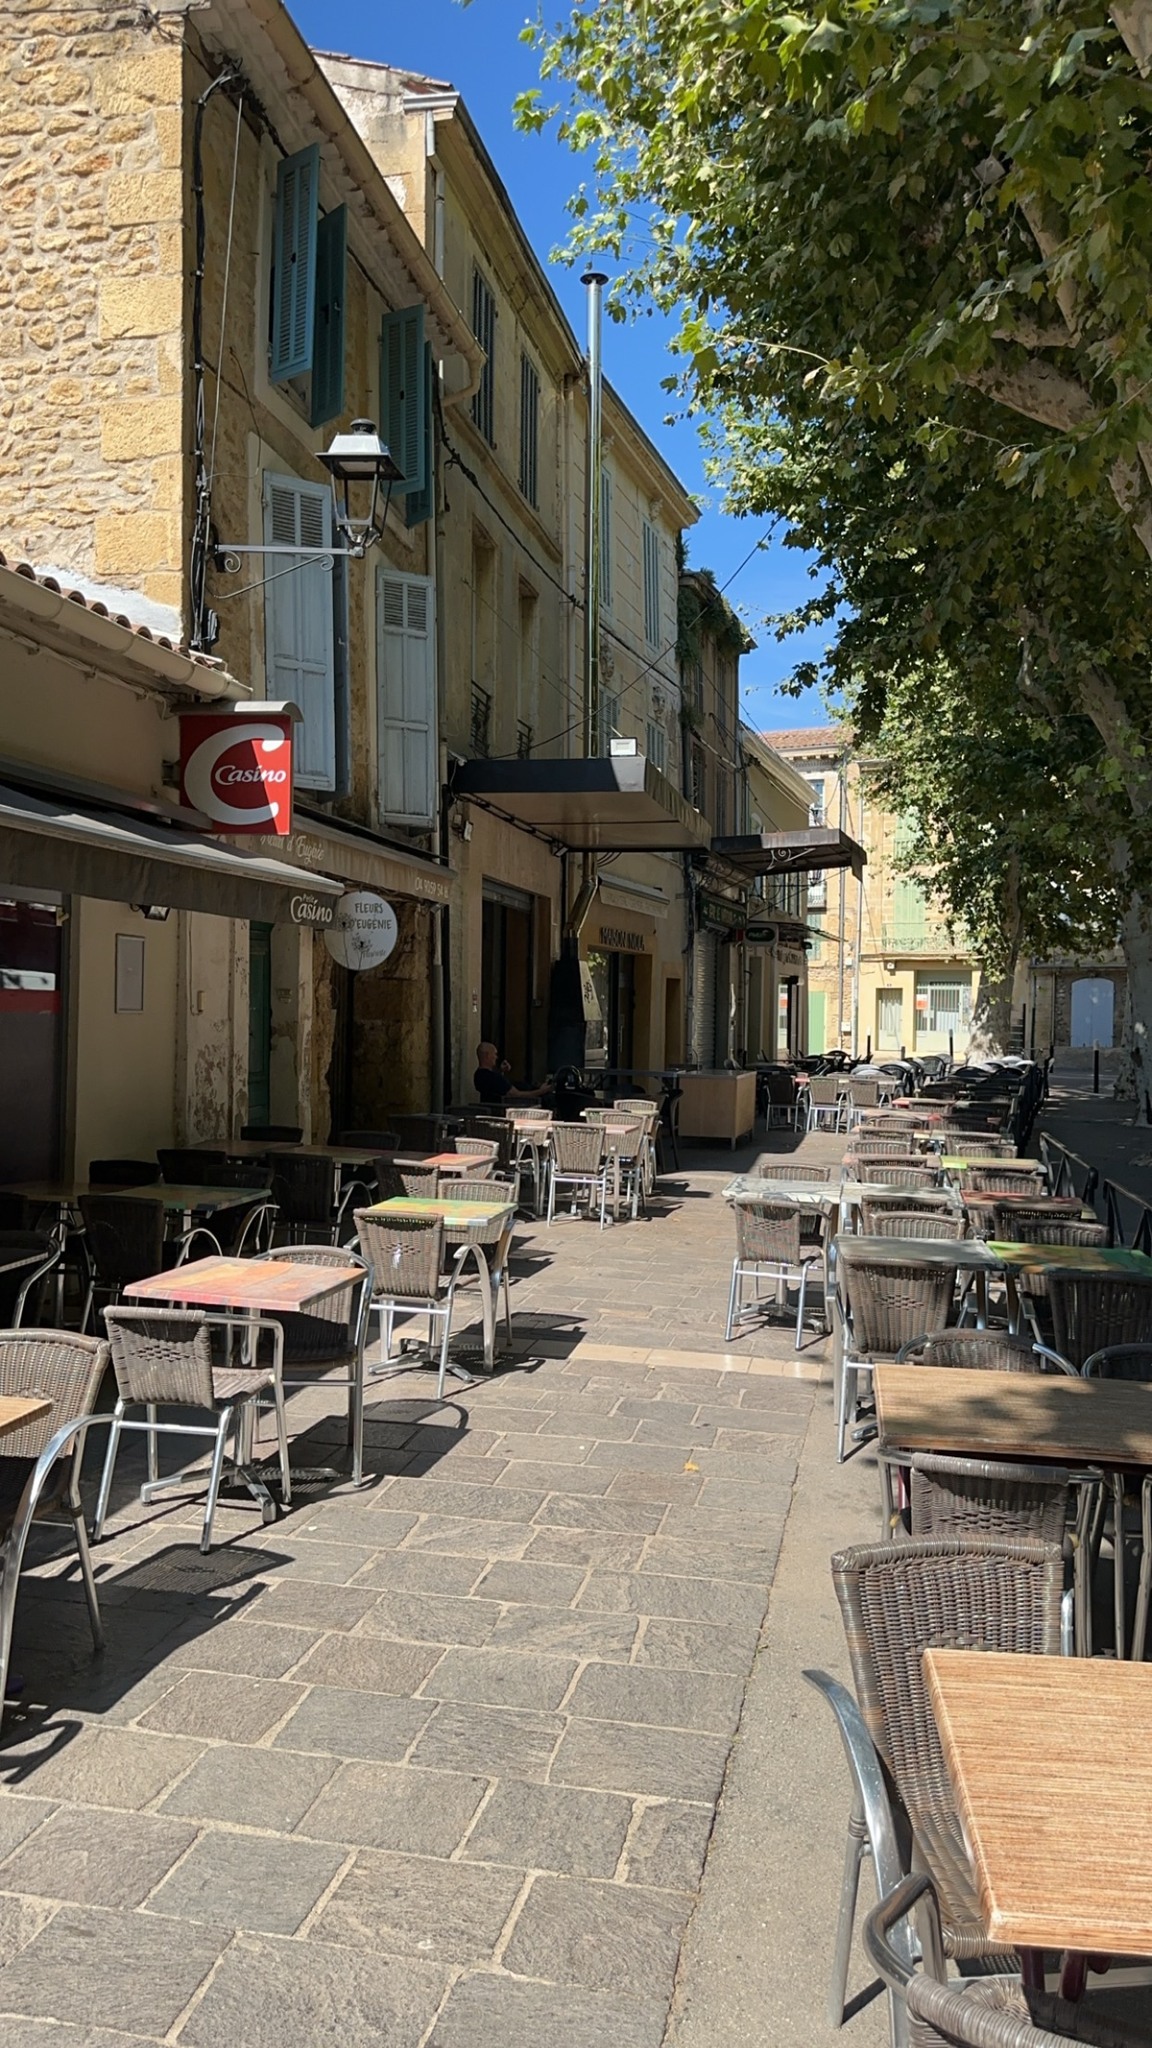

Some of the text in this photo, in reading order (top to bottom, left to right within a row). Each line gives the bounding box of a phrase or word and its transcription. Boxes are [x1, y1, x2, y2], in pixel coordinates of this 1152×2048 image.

[215, 765, 287, 785] Casino
[290, 896, 333, 923] Casino
[354, 902, 383, 914] FLEURS
